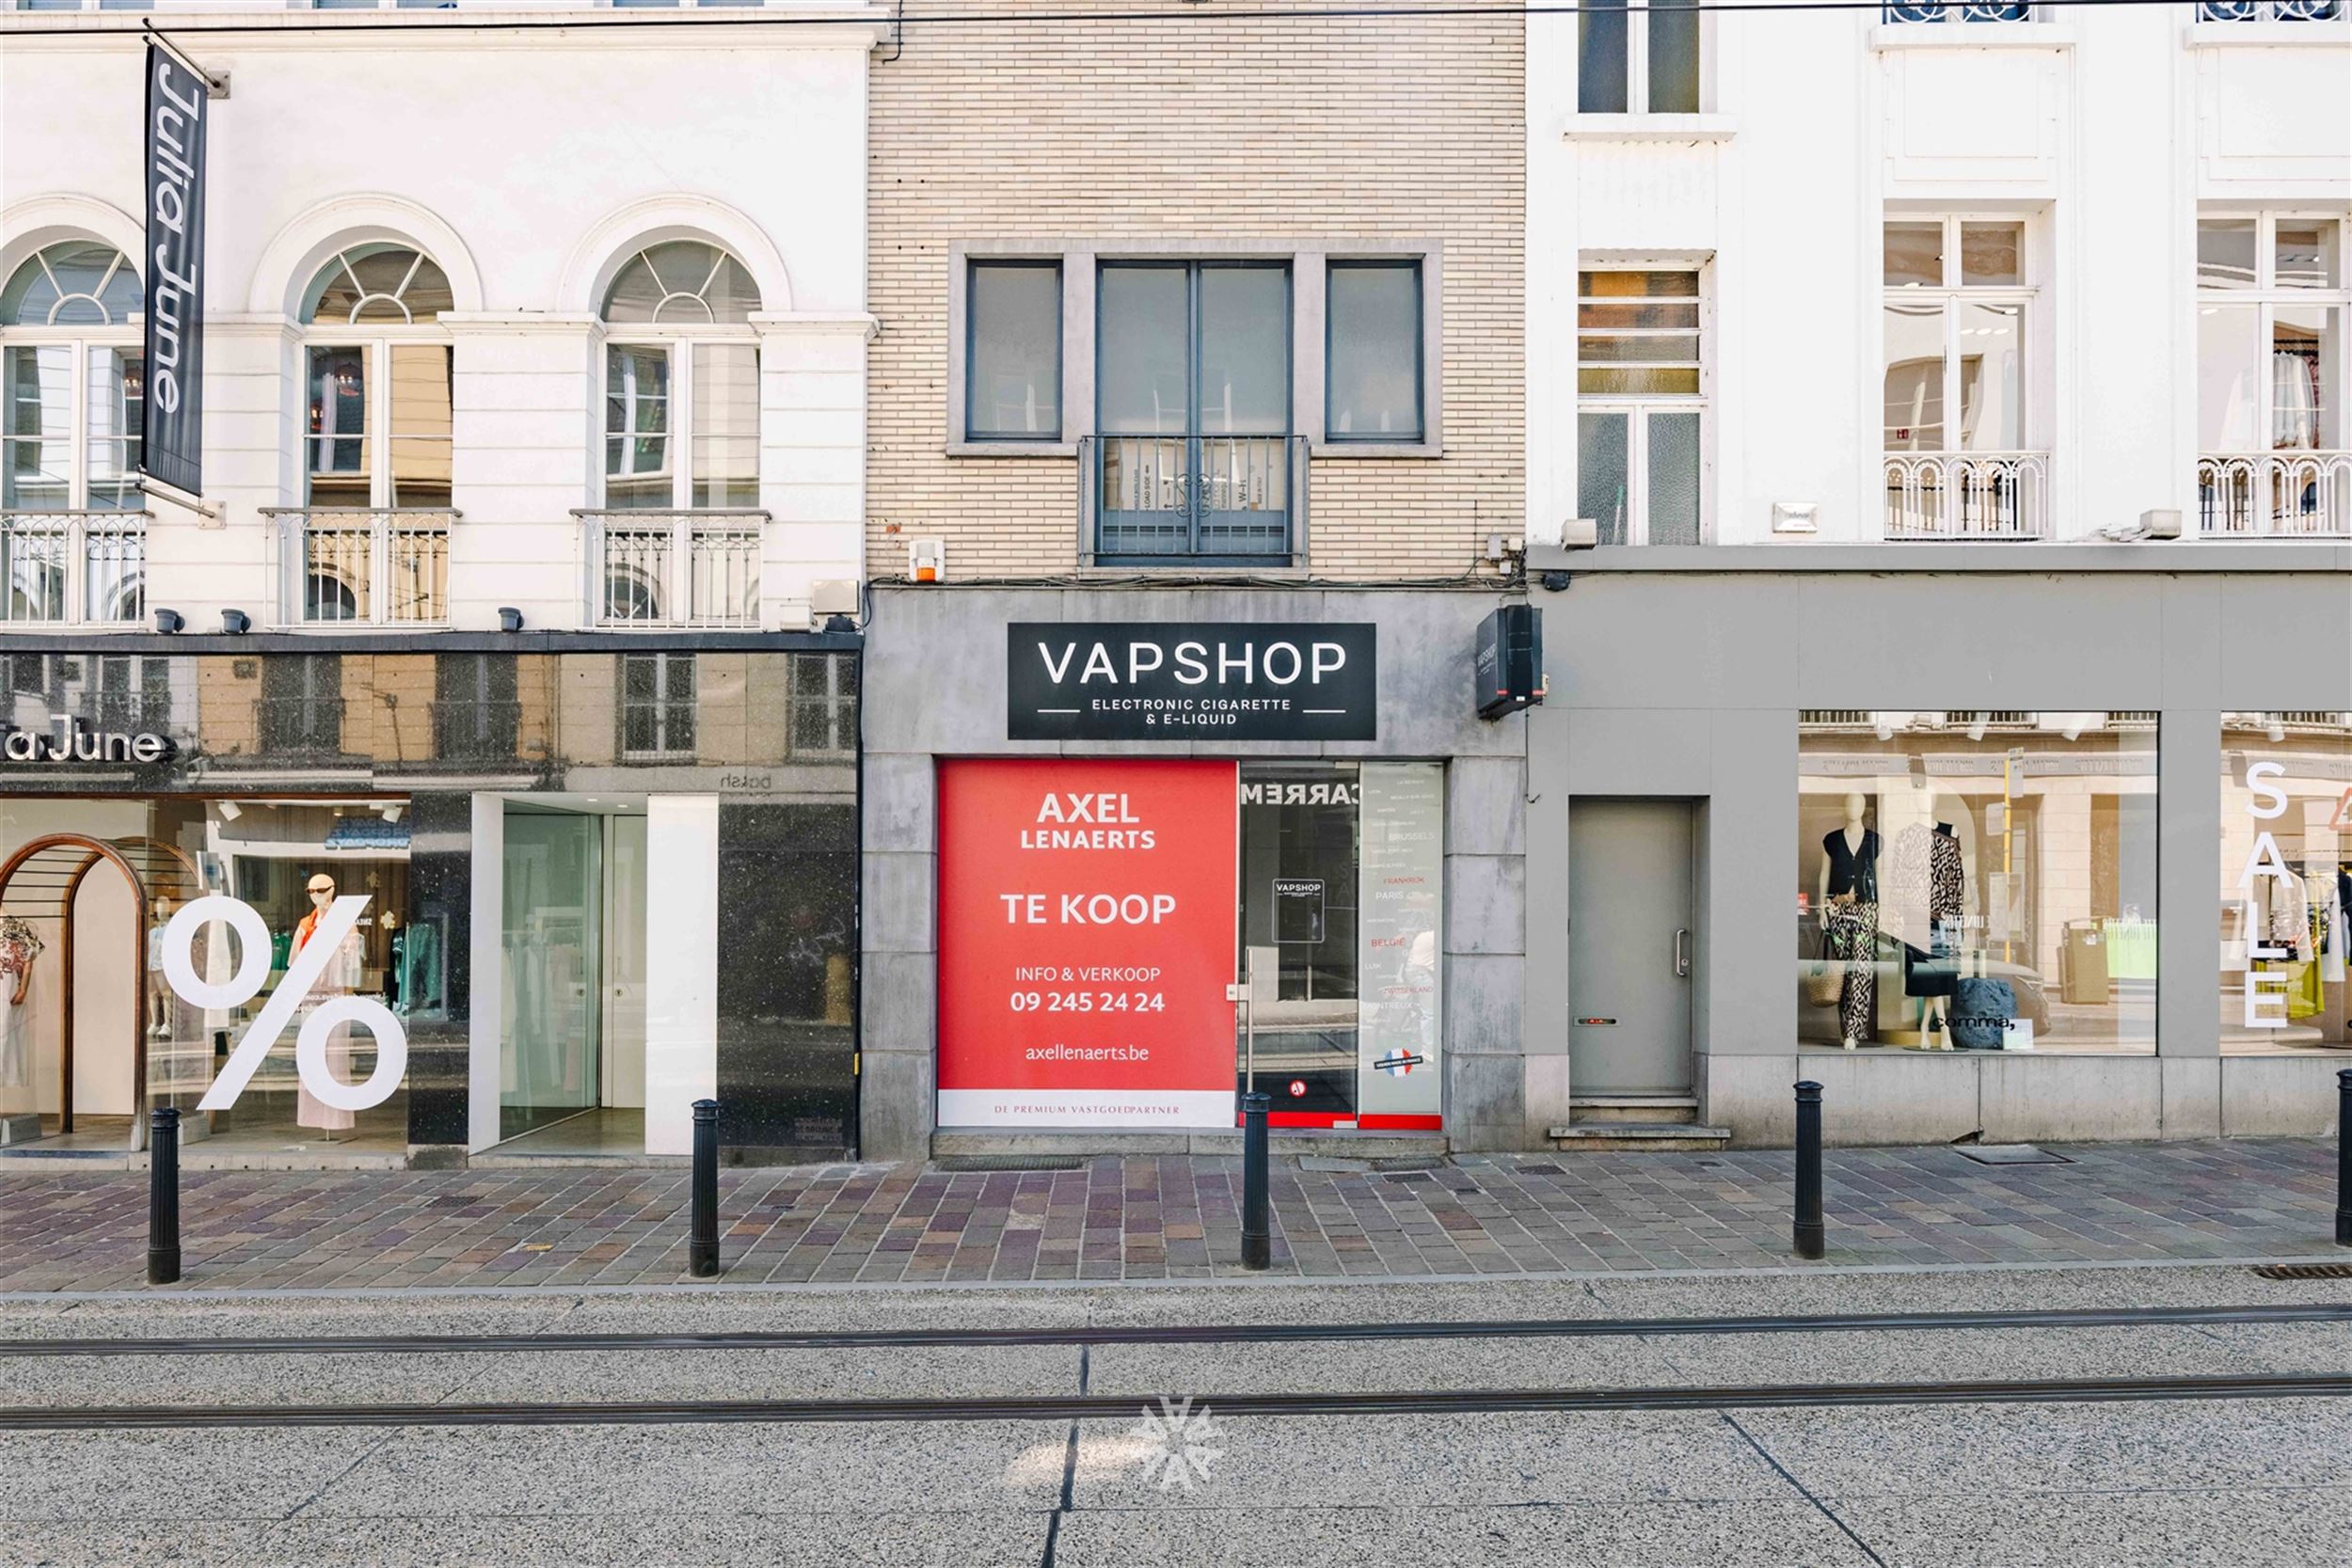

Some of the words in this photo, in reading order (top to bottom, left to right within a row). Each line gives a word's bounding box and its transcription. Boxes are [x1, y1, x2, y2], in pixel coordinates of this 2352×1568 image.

[155, 62, 199, 235] Julia
[154, 244, 196, 414] June
[1038, 641, 1346, 685] VAPSHOP
[1091, 699, 1194, 710] ELECTRONIC
[1200, 699, 1291, 710] CIGARETTE
[1145, 714, 1156, 725] &
[1163, 714, 1237, 725] E-LIQUID
[48, 714, 164, 762] June
[1036, 793, 1140, 824] AXEL
[1021, 830, 1155, 849] LENAERTS
[1389, 832, 1436, 842] BRUSSELS
[1276, 883, 1321, 892] VAPSHOP
[1375, 892, 1404, 900] PARIS
[2237, 761, 2294, 1028] SALE
[1000, 894, 1046, 924] TE
[1060, 894, 1176, 924] KOOP
[1015, 967, 1057, 982] INFO
[1060, 967, 1074, 982] &
[1078, 967, 1162, 982] VERKOOP
[1010, 991, 1041, 1012] 09
[1047, 991, 1093, 1012] 245
[1099, 991, 1129, 1012] 24
[1134, 991, 1166, 1012] 24
[1933, 1017, 2015, 1031] comma,
[1025, 1044, 1150, 1062] axellenaerts.be
[993, 1105, 1009, 1115] DE
[1013, 1105, 1067, 1115] PREMIUM
[1071, 1105, 1181, 1115] VASTGOEDPARTNER
